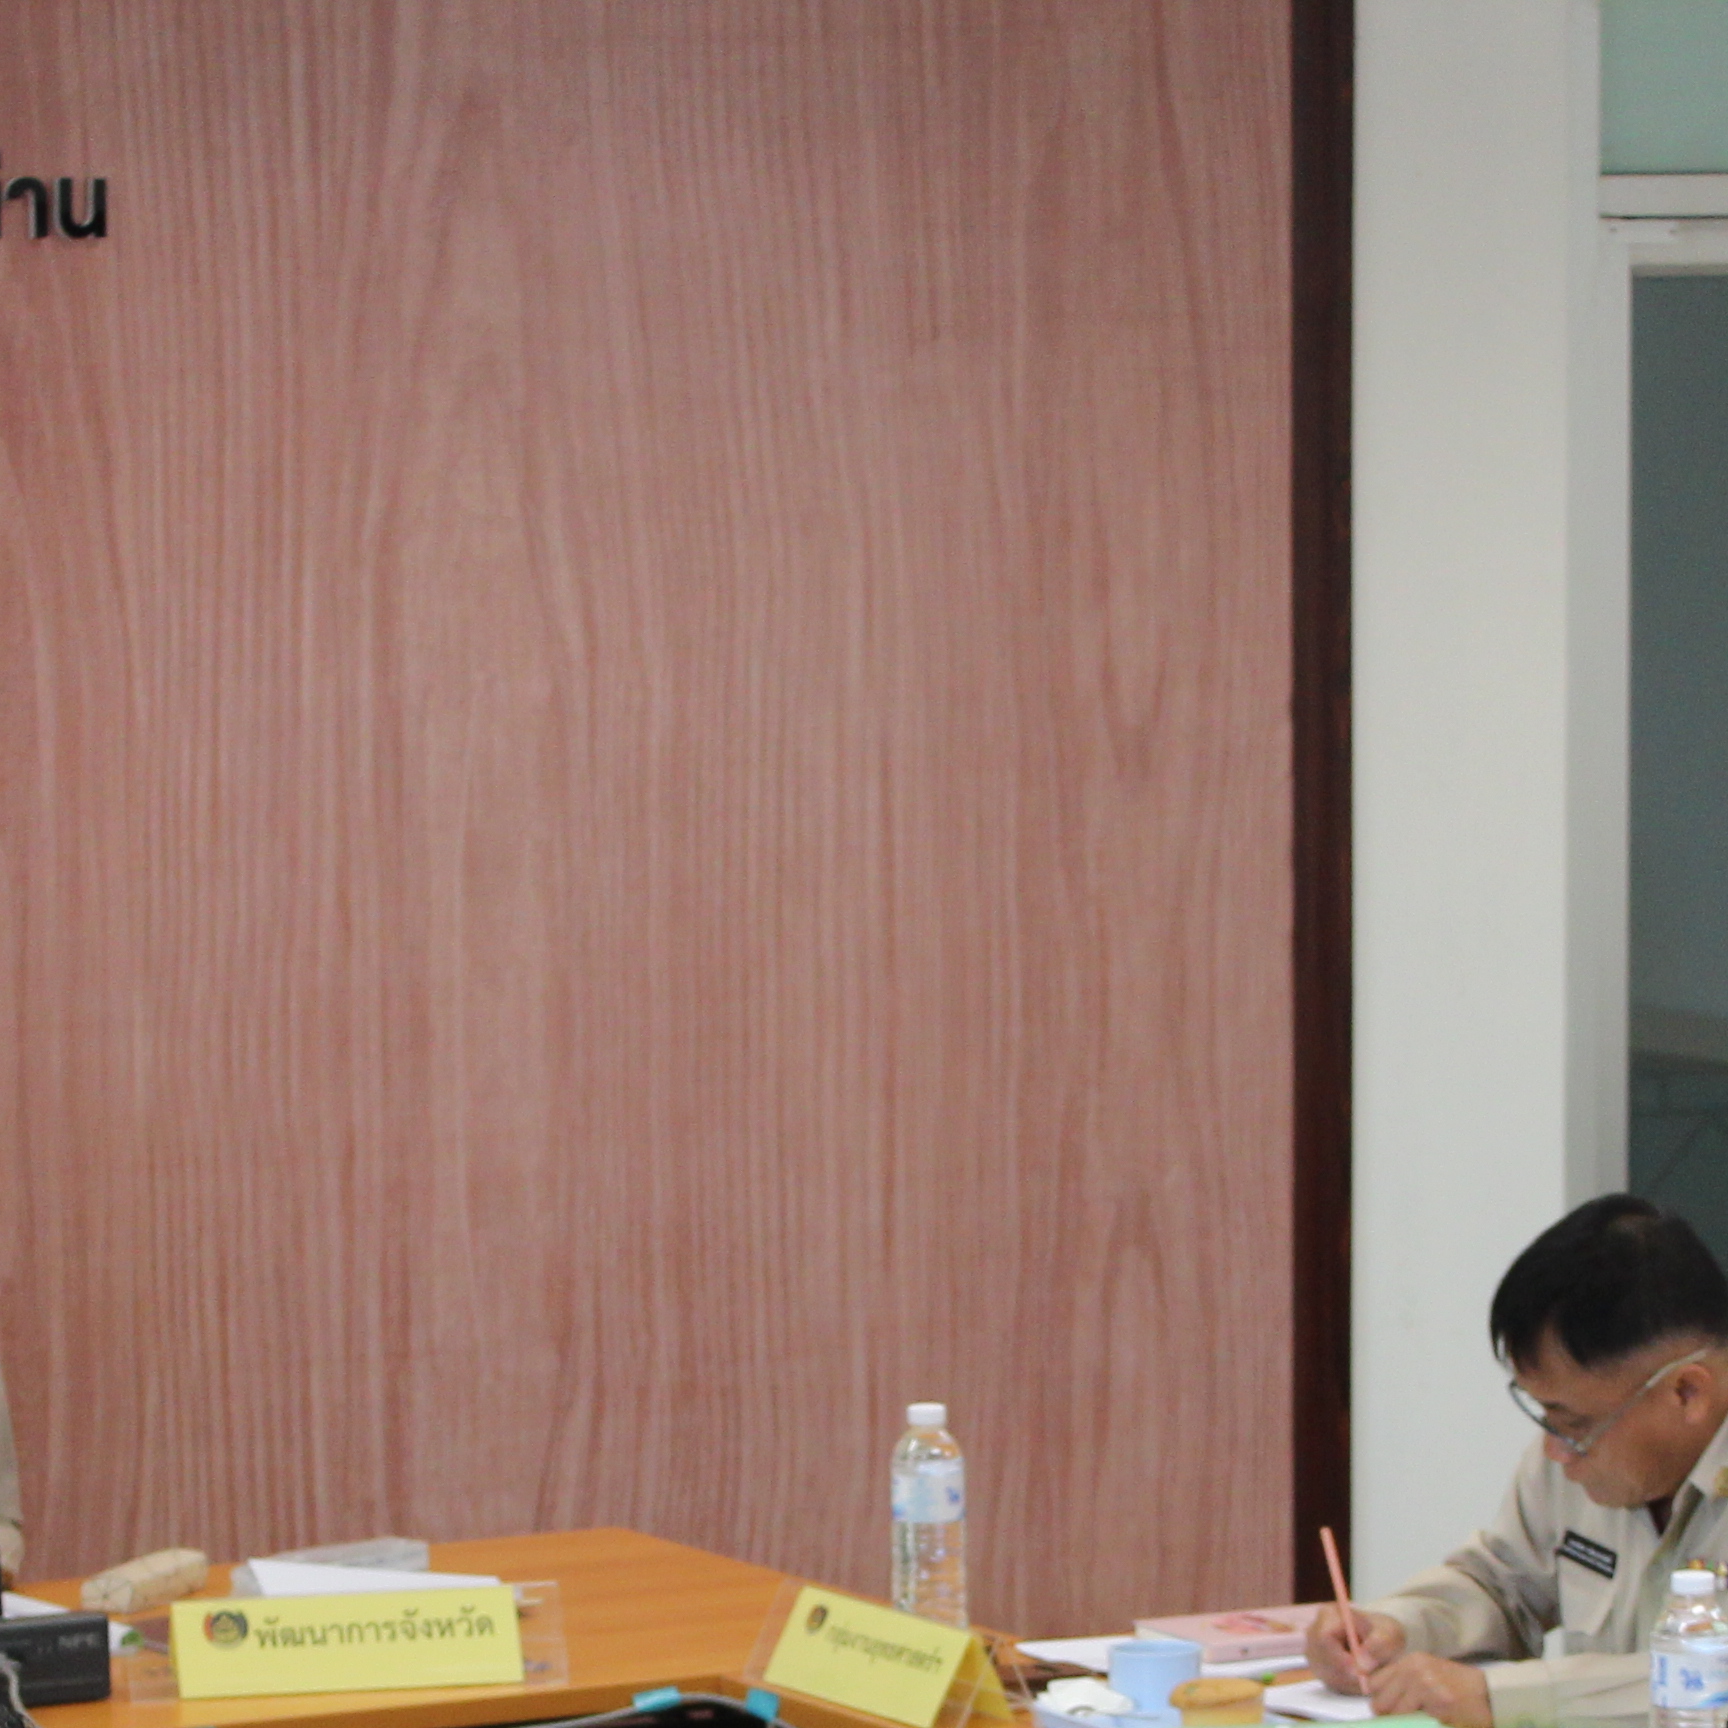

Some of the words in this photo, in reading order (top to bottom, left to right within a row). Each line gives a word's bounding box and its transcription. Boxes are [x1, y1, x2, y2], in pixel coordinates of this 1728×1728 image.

[254, 1605, 494, 1648] พัฒนาการจังหวัด
